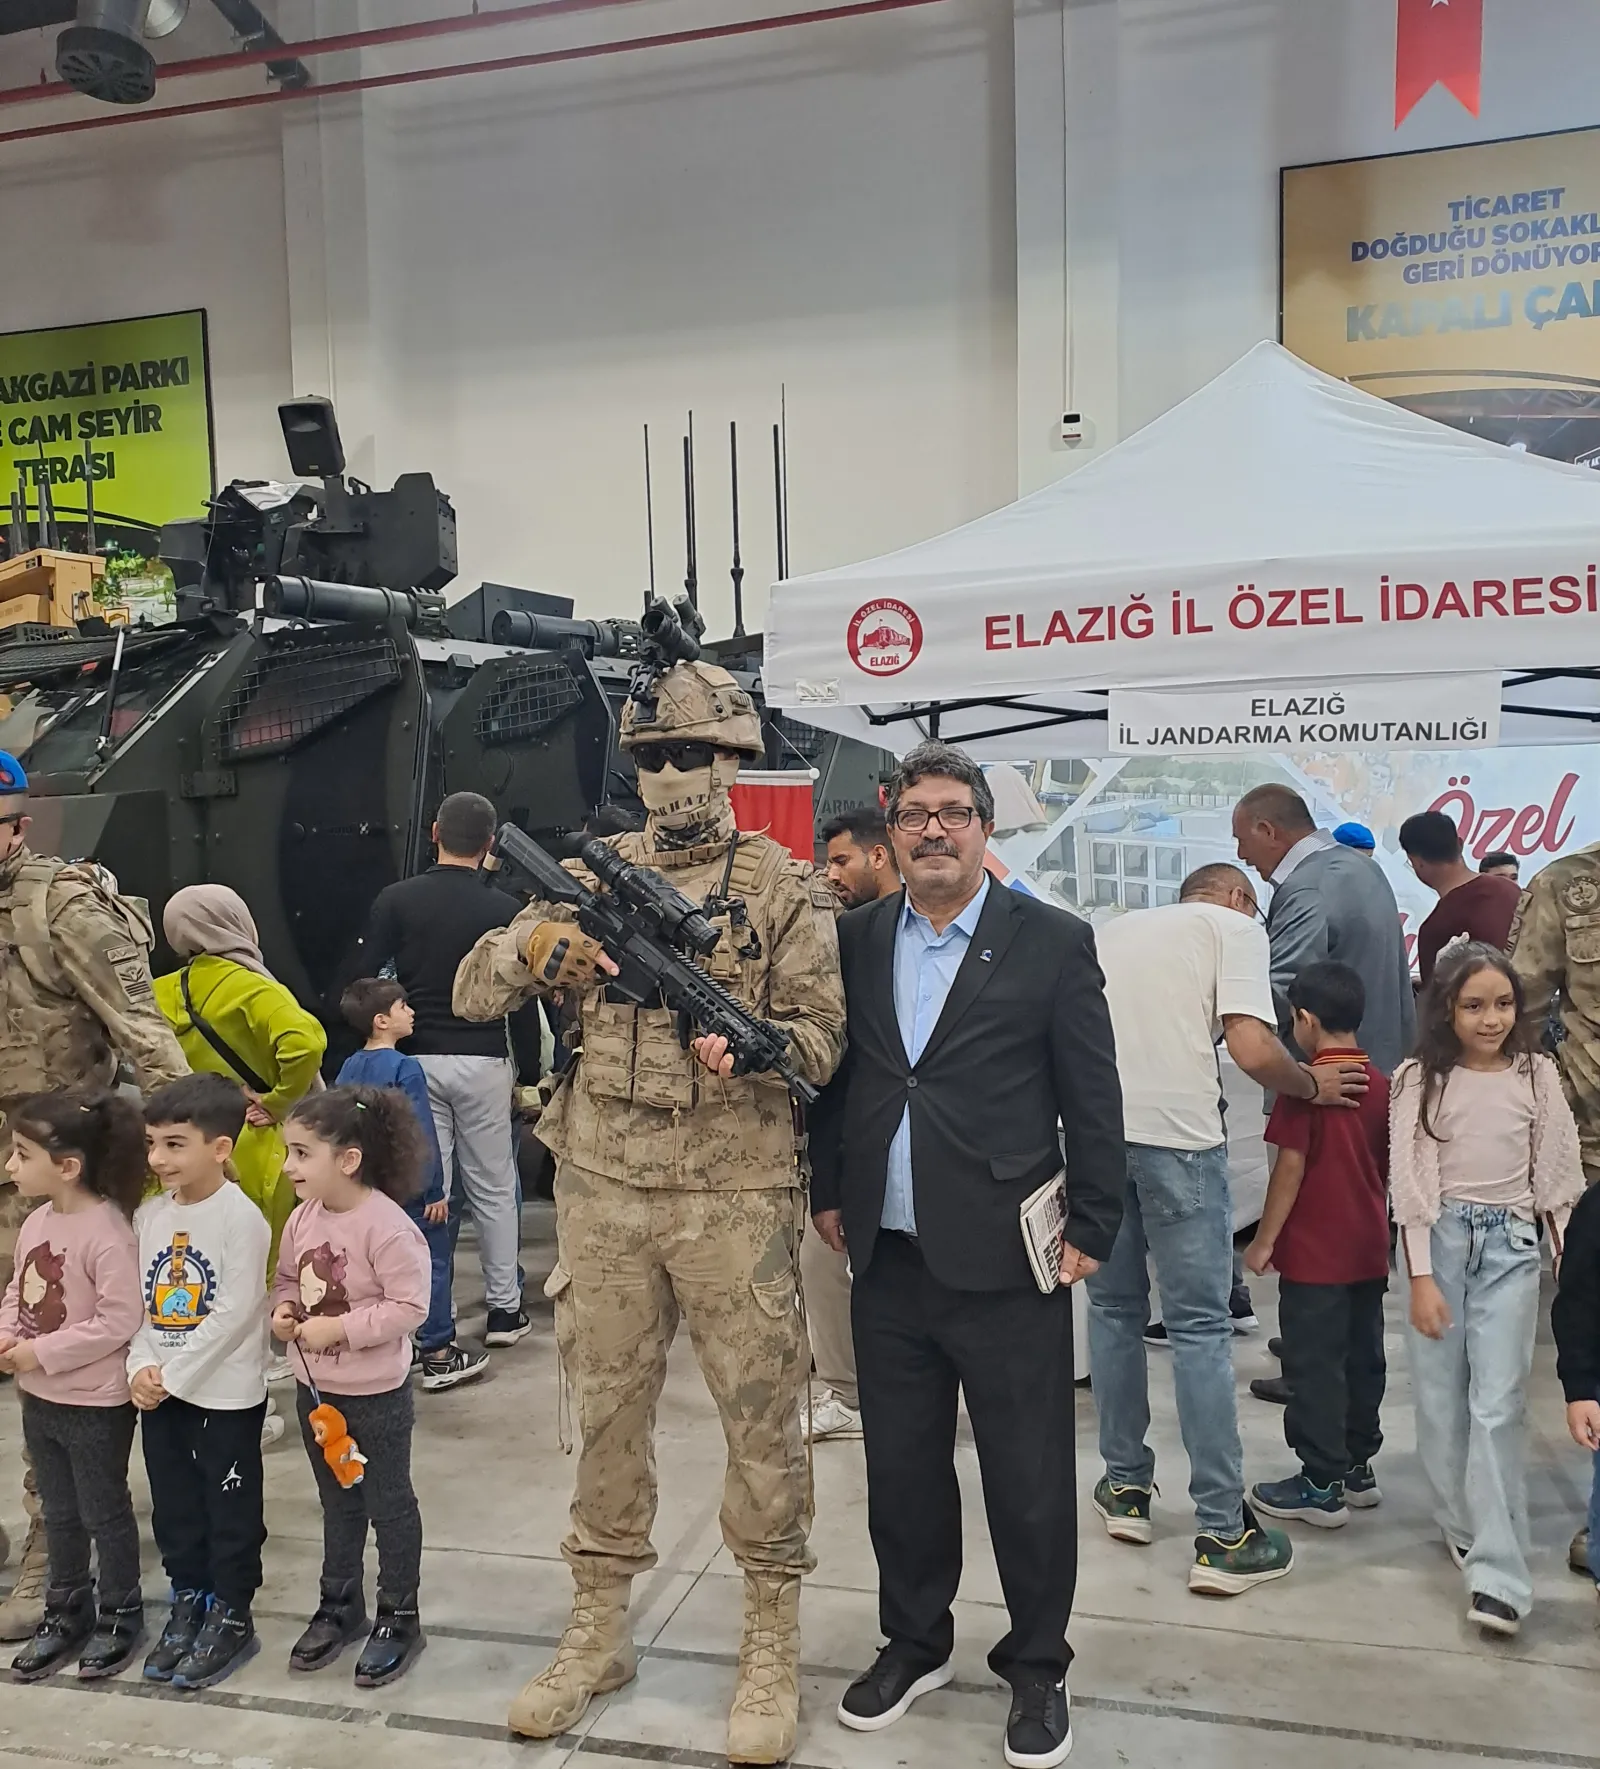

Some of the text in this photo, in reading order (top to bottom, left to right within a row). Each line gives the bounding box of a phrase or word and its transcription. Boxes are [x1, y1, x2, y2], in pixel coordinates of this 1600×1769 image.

[1448, 187, 1565, 221] TİCARET
[1351, 224, 1486, 262] DOĞDUĞU
[1403, 254, 1465, 284] GERİ
[1347, 289, 1512, 342] KAPALI
[101, 356, 190, 394] PARKI
[8, 413, 72, 445] CAM
[77, 399, 163, 439] SEYİR
[13, 451, 115, 487] TERASI
[883, 601, 916, 623] İDARESİ
[985, 564, 1597, 650] ELAZIĞ İL ÖZEL İDARESİ
[870, 653, 900, 667] ELAZIĞ
[1251, 692, 1345, 717] ELAZIĞ
[1119, 716, 1487, 746] İL JANDARMA KOMUTANLIĞI
[1425, 772, 1580, 860] Özel
[162, 1332, 187, 1340] START
[222, 1479, 241, 1492] AIR
